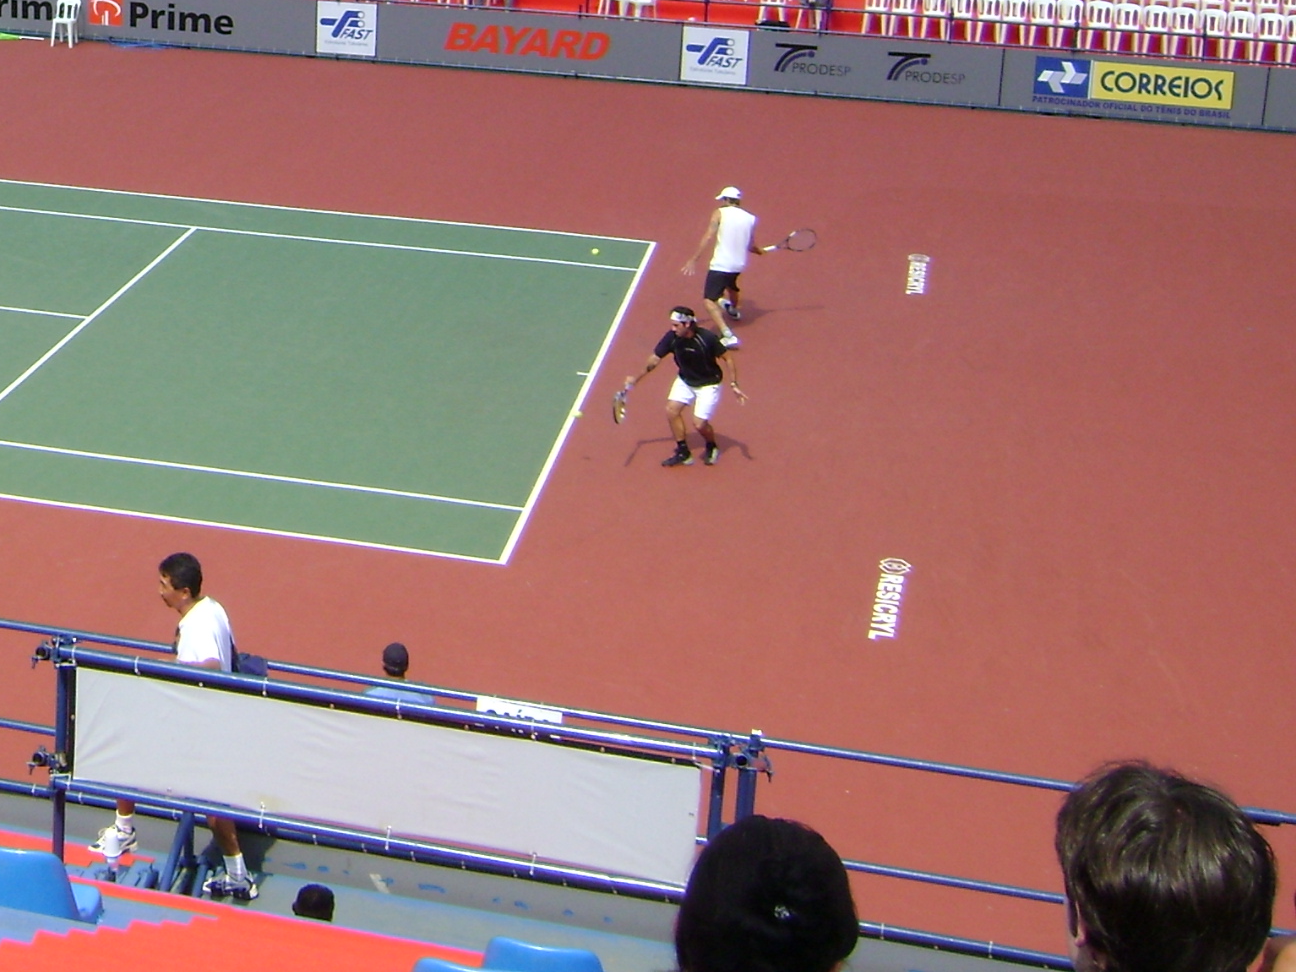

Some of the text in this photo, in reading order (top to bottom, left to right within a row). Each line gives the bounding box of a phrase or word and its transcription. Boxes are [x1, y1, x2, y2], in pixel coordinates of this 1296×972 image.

[129, 1, 234, 35] Prime
[341, 29, 373, 41] FAST
[443, 22, 611, 62] BAYARD
[706, 55, 743, 69] FAST
[791, 61, 852, 77] PRODESP
[905, 69, 966, 85] PRODESP
[1100, 69, 1224, 101] CORREIOS
[1031, 94, 1101, 109] PATROCINADOR
[1103, 101, 1138, 112] OFICIAL
[1140, 104, 1154, 113] DO
[1184, 108, 1198, 117] DO
[1199, 108, 1232, 119] BRASIL
[868, 573, 904, 639] RESICRYL
